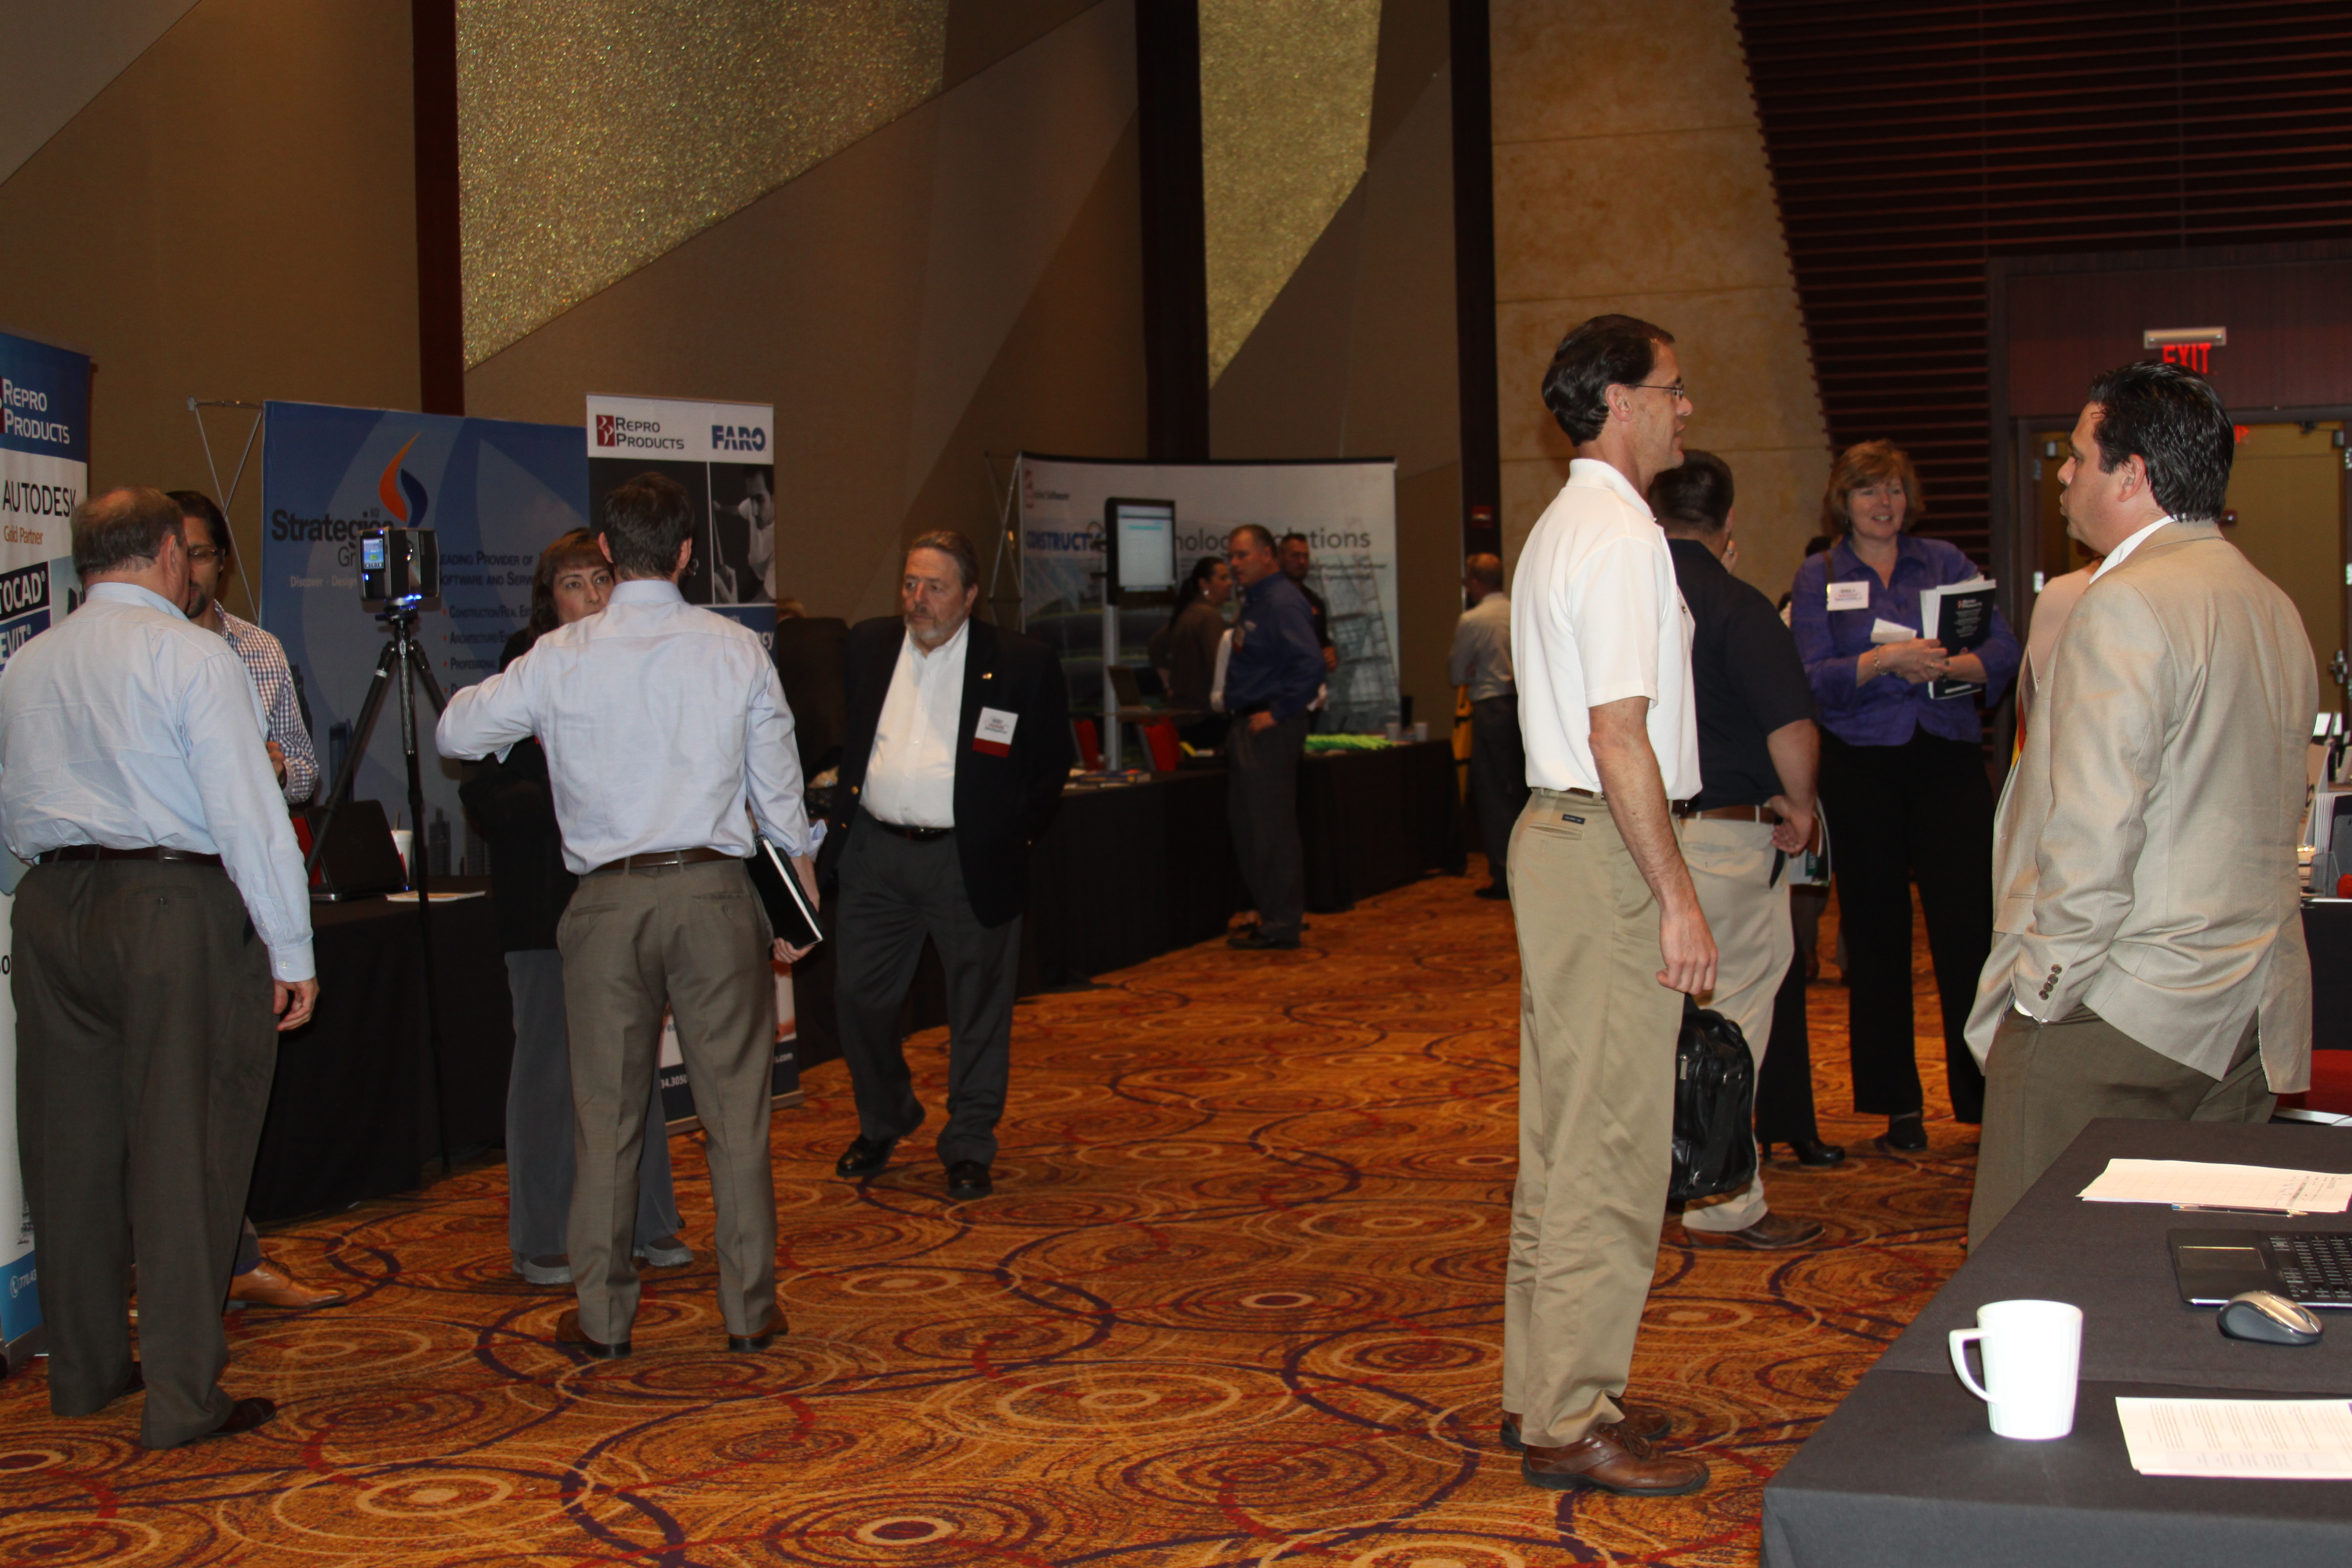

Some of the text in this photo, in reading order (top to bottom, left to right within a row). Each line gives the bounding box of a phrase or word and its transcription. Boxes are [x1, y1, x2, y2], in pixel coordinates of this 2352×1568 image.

[2162, 343, 2212, 374] EXIT
[2, 378, 48, 412] REPRO
[4, 407, 70, 444] PRODUCTS
[615, 417, 660, 433] REPRO
[616, 433, 685, 449] PRODUCTS
[711, 425, 766, 451] FARO
[3, 479, 77, 518] AUTODESK
[4, 525, 43, 545] Gold Partner
[339, 546, 357, 567] Gr
[477, 550, 520, 566] PROVIDER
[523, 555, 534, 566] OF
[487, 575, 504, 585] AND
